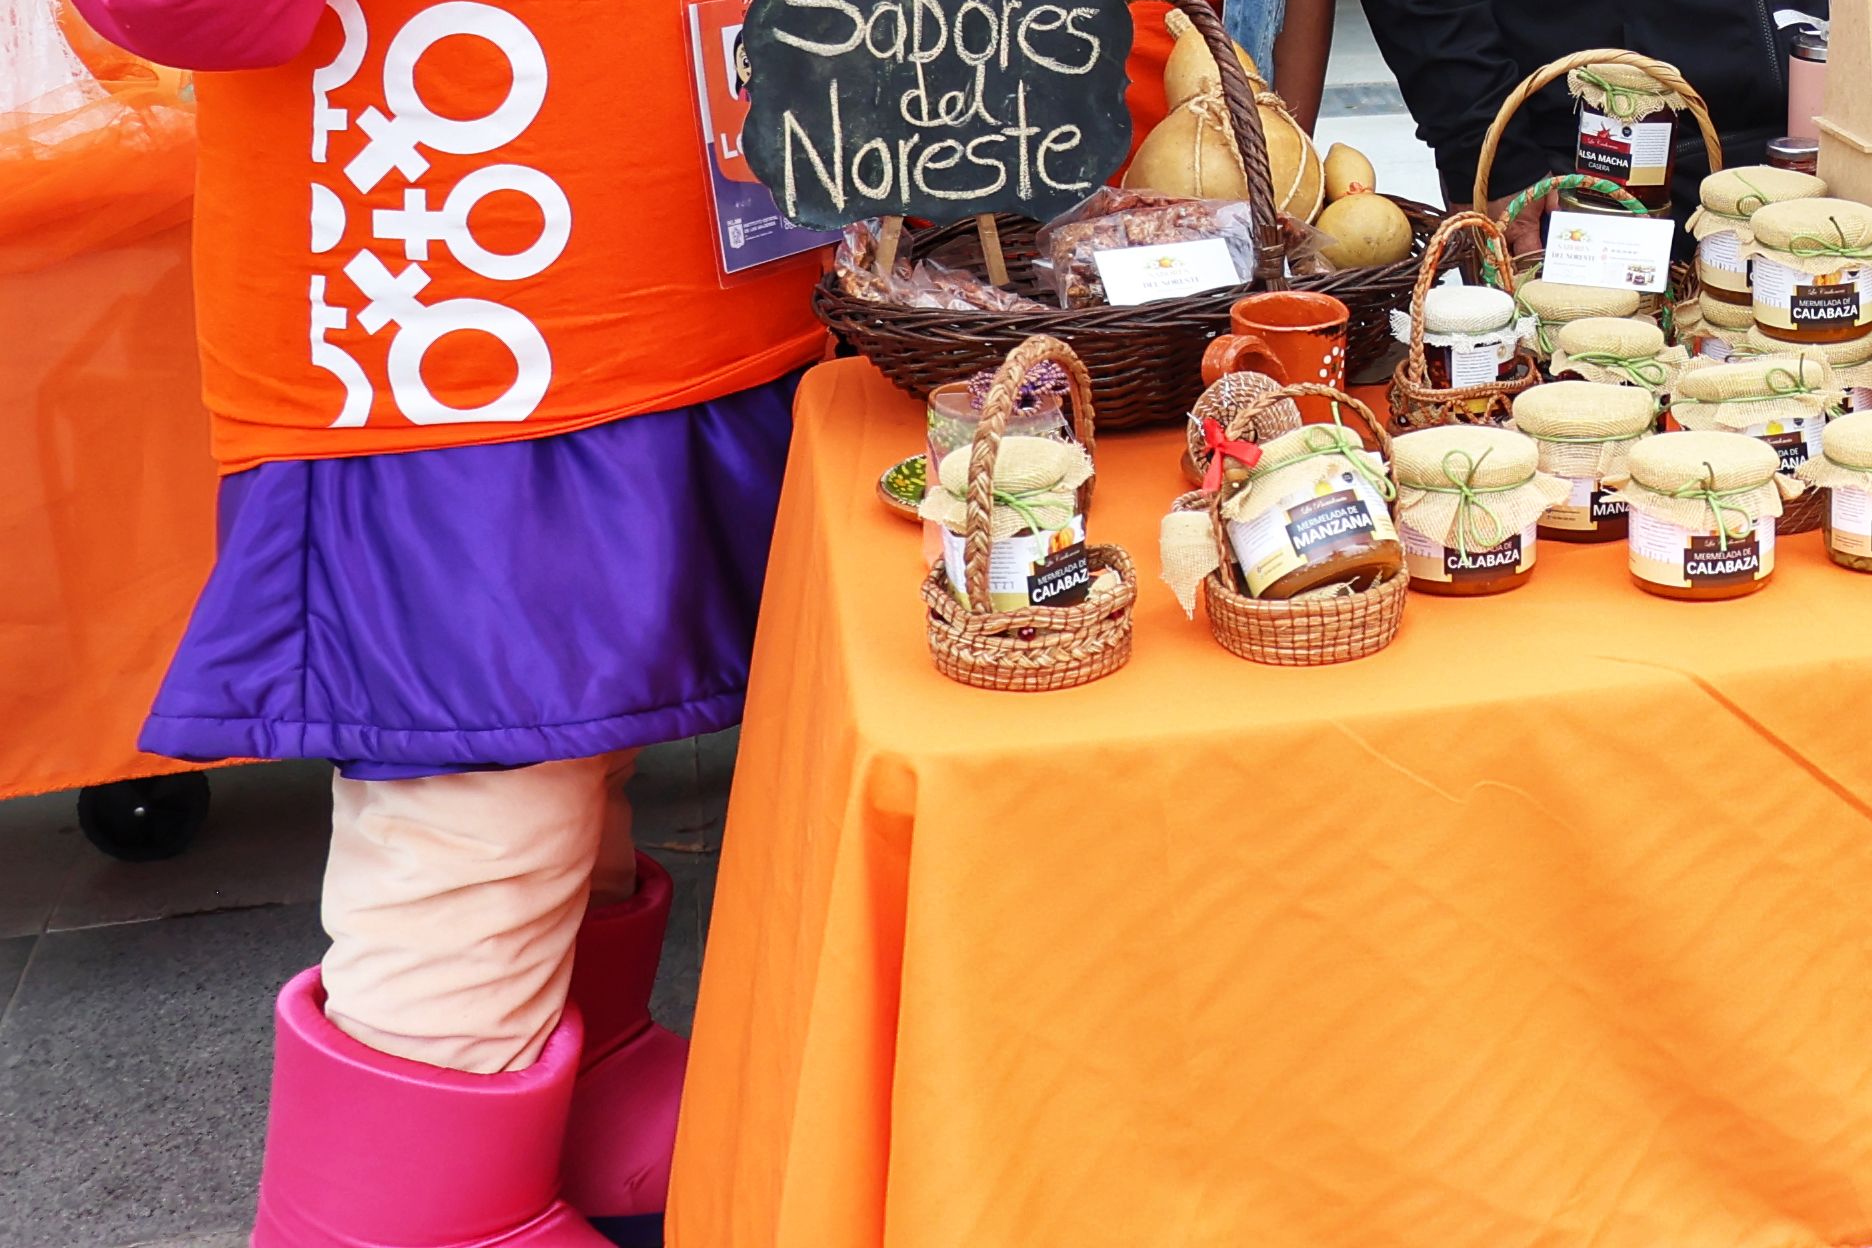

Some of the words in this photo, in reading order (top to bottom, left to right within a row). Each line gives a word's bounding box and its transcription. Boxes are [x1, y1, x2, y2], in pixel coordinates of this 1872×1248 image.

[901, 60, 1002, 127] del
[782, 78, 1094, 218] Noreste
[1579, 149, 1597, 161] ALSA
[1597, 153, 1629, 168] MACHA
[1588, 161, 1610, 172] CASERA
[1792, 304, 1858, 320] CALABAZA
[1799, 299, 1841, 307] MERMELADA
[1296, 508, 1348, 532] MERMELADA
[1347, 505, 1359, 515] DE
[1292, 512, 1373, 550] MANZANA
[1447, 549, 1520, 569] CALABAZA
[1693, 549, 1742, 561] MERMELADA
[1743, 547, 1752, 556] DE
[1037, 563, 1079, 586] MERMELADA
[1686, 555, 1758, 575] CALABAZA
[1032, 567, 1090, 603] CALABAZ
